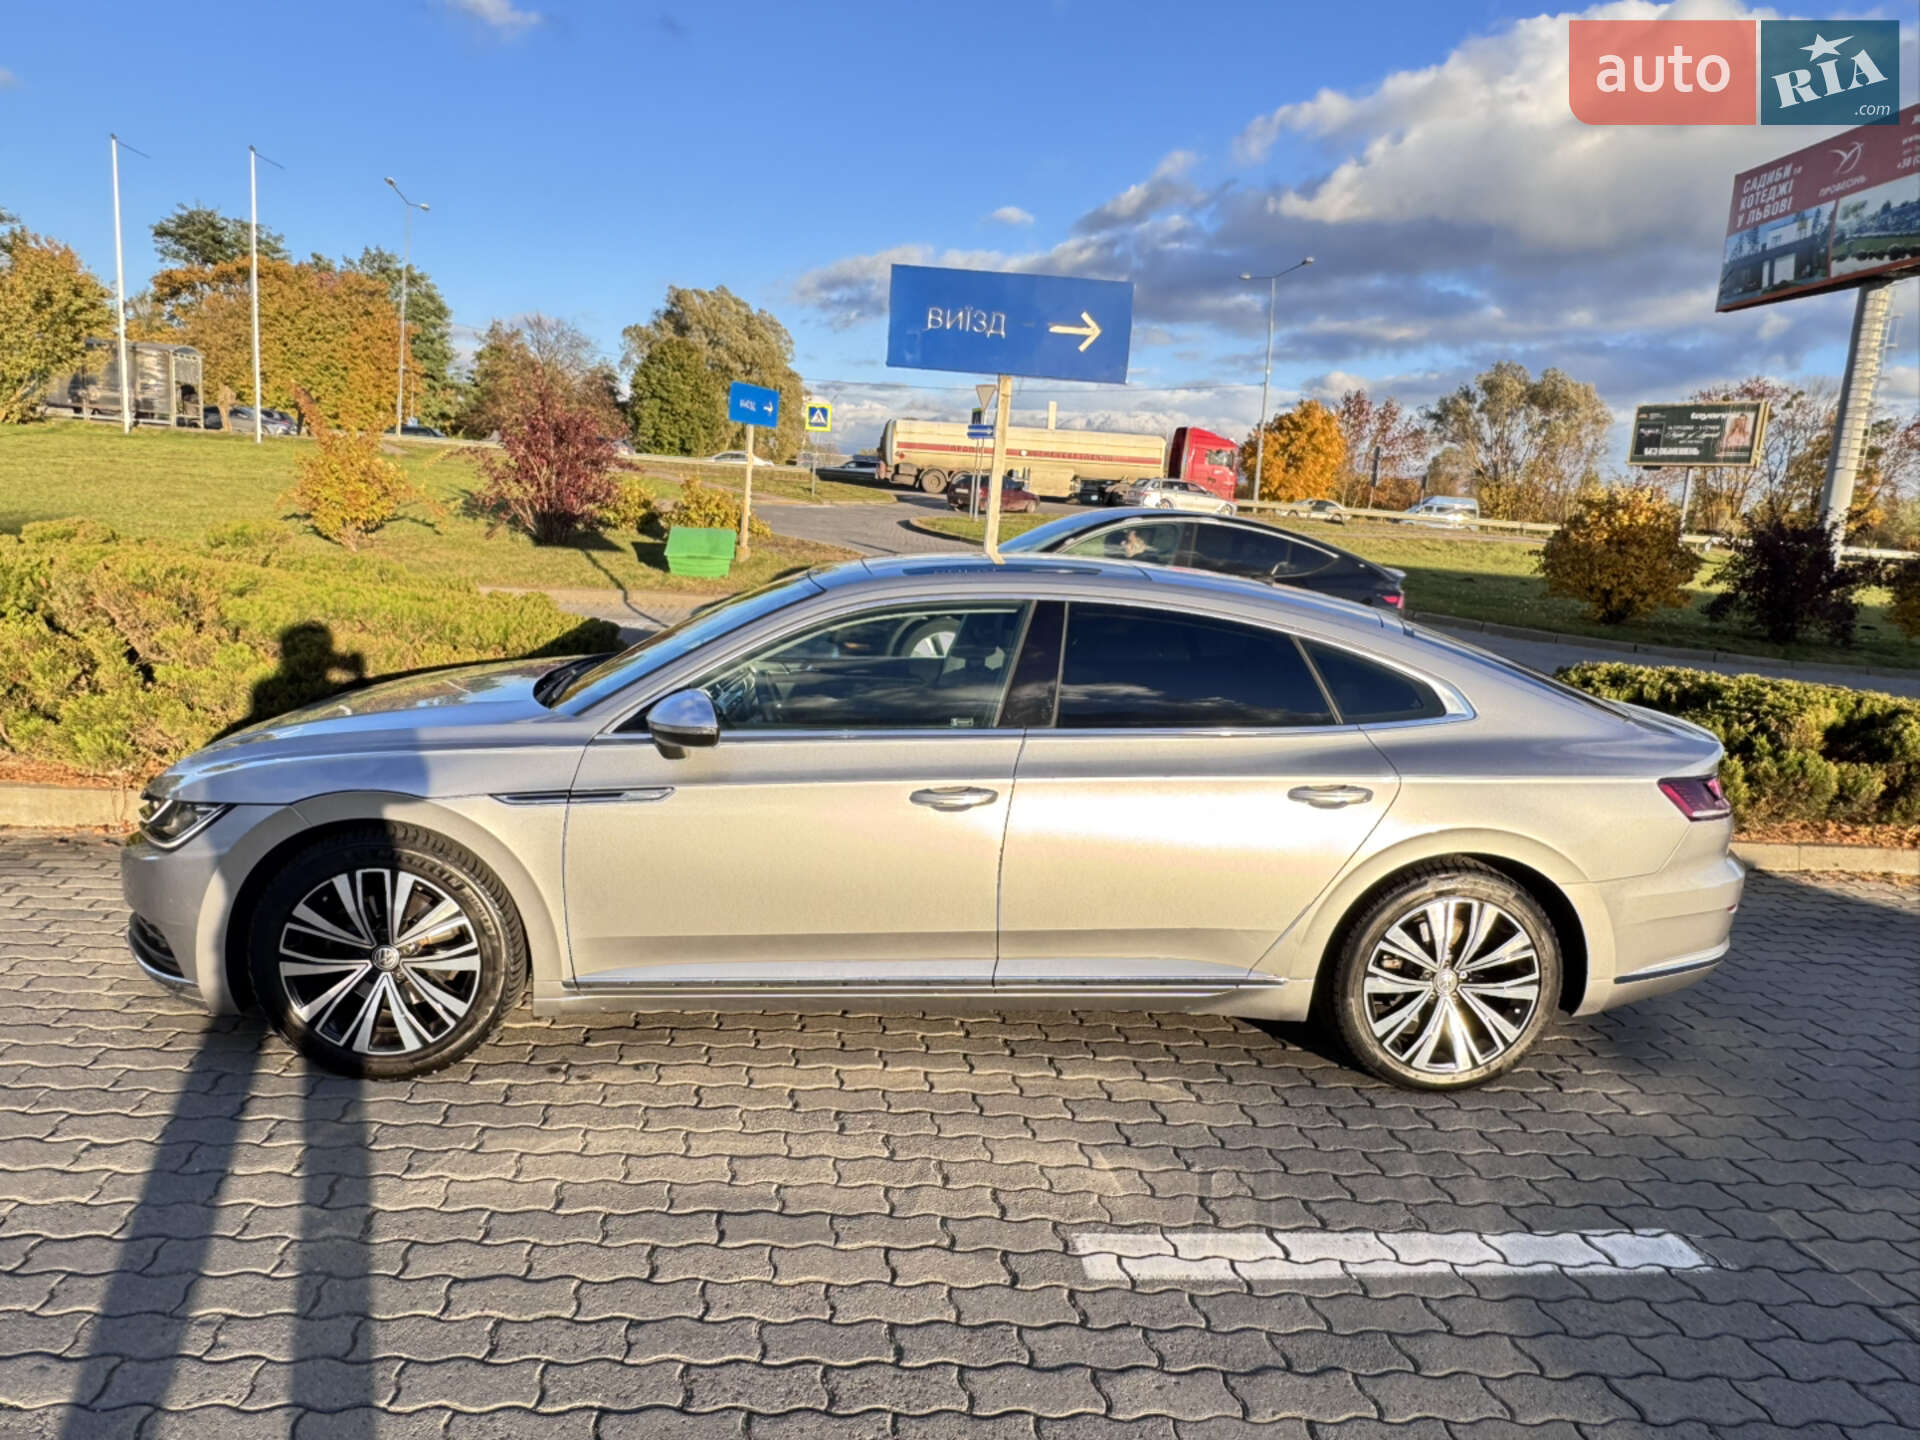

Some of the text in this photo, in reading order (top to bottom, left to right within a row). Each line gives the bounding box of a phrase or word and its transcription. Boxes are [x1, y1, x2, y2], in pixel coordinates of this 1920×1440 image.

[1743, 162, 1793, 194] САДИБИ
[1739, 179, 1794, 212] КОТЕДЖІ
[1746, 197, 1793, 225] ЛЬВОВІ
[927, 306, 1006, 339] ВИЇЗД
